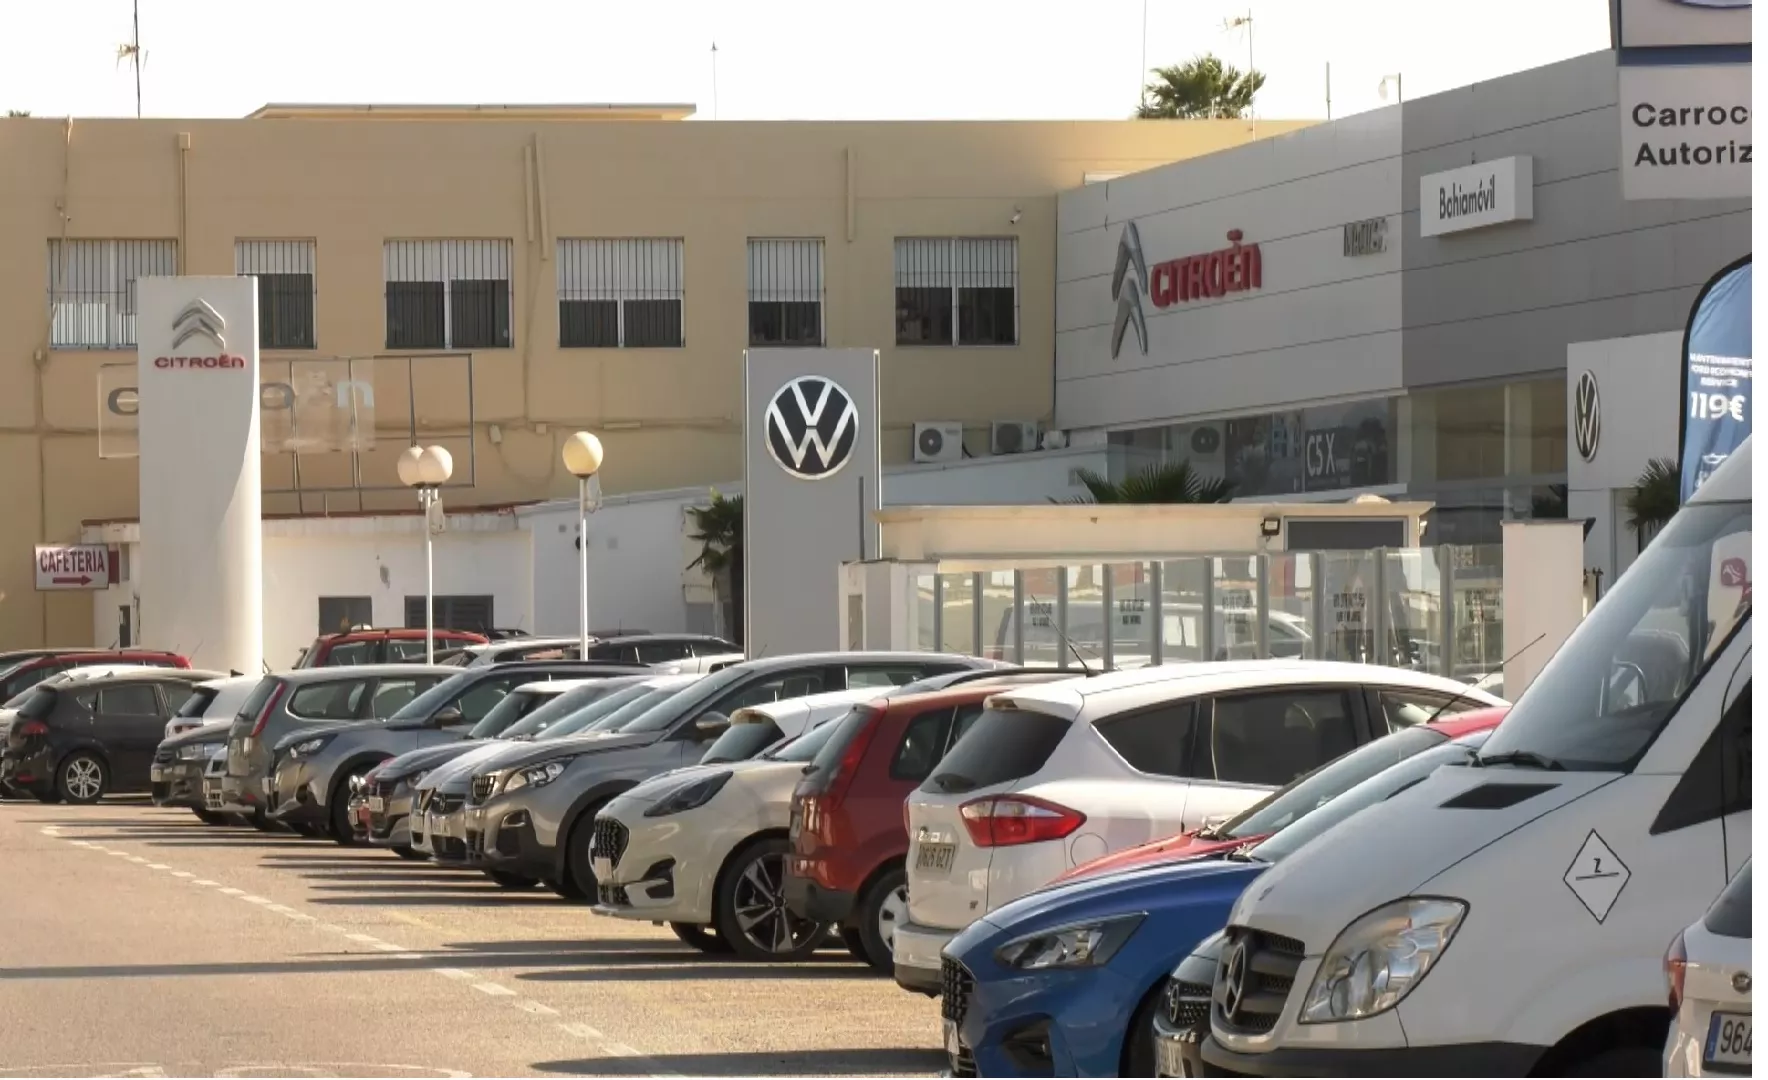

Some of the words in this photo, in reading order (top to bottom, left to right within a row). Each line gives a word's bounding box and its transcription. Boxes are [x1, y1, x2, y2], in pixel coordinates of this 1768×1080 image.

[1632, 102, 1752, 128] Carroc
[1691, 391, 1746, 422] 119€
[1307, 434, 1323, 477] C5
[1325, 432, 1336, 475] X
